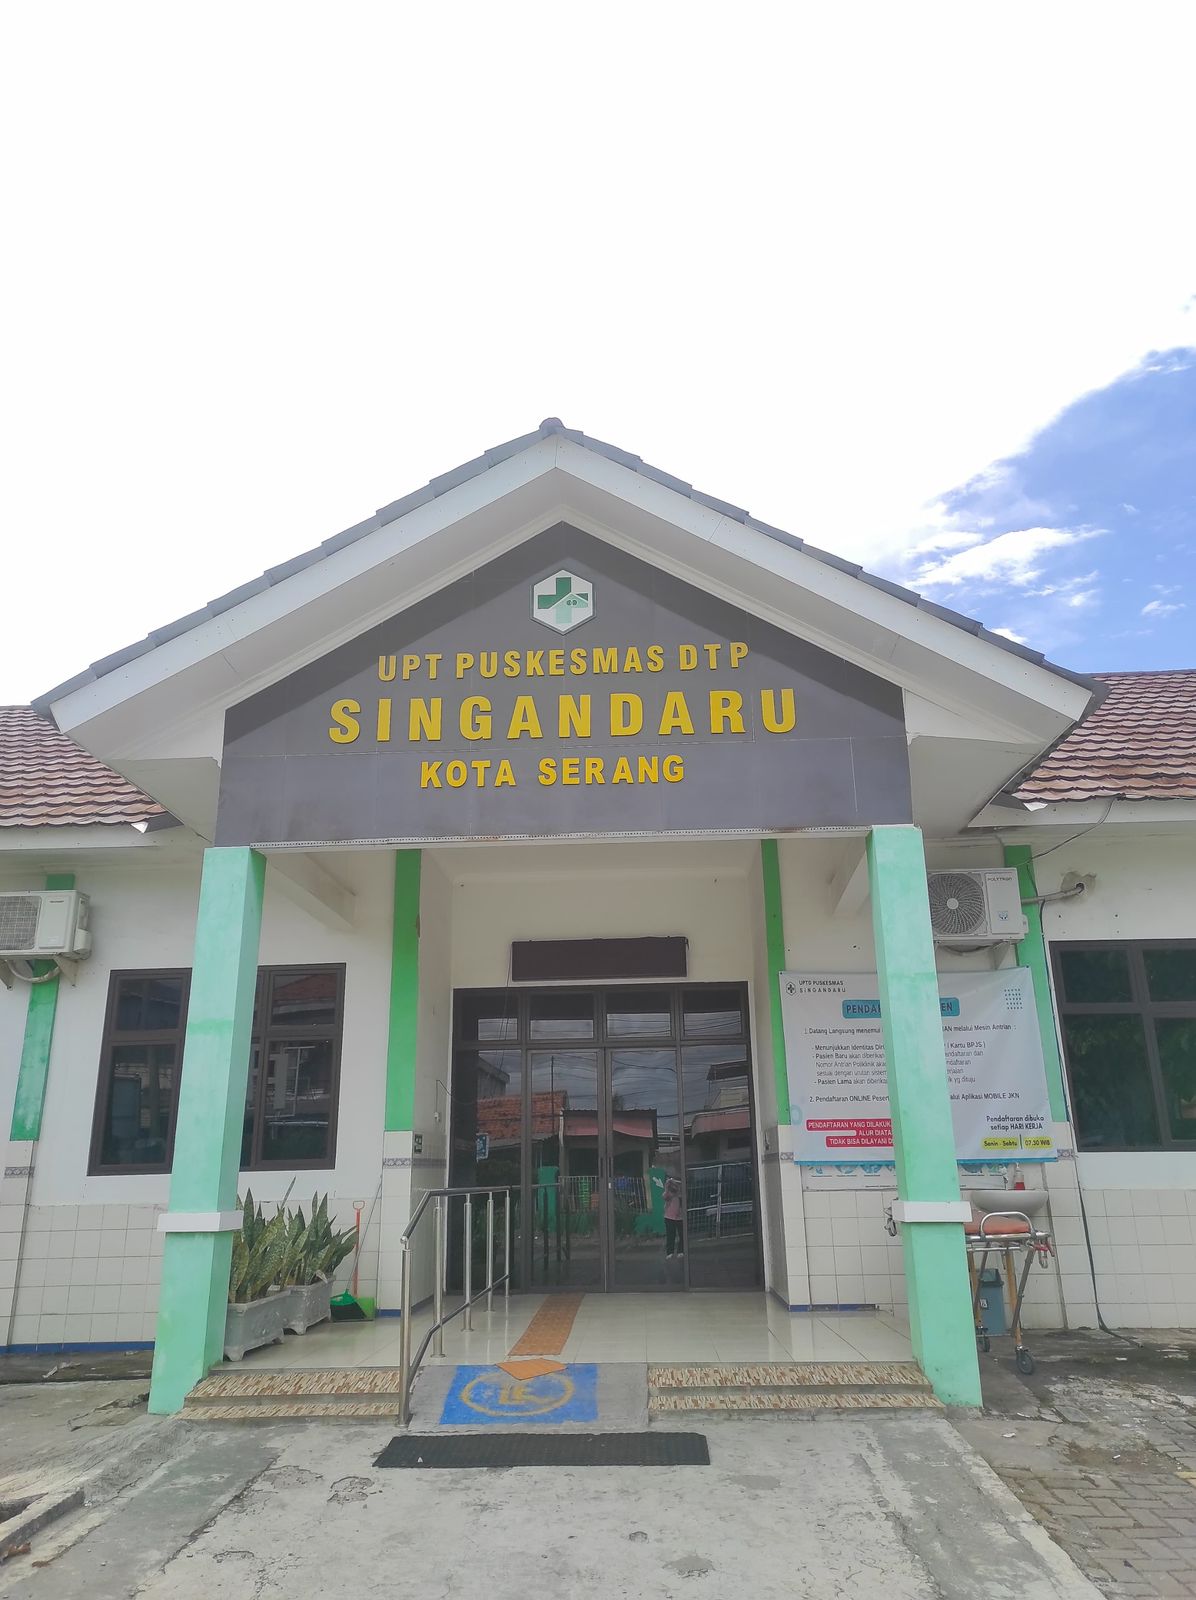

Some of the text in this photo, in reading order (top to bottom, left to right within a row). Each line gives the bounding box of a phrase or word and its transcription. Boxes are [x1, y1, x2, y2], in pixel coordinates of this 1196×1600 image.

[378, 642, 750, 682] UPT PUSKESMAS DTP
[328, 688, 797, 744] SINGANDARU
[420, 754, 685, 788] KOTA SERANG
[808, 1121, 849, 1129] PENDAFTARAN
[1025, 1122, 1043, 1130] KERJA
